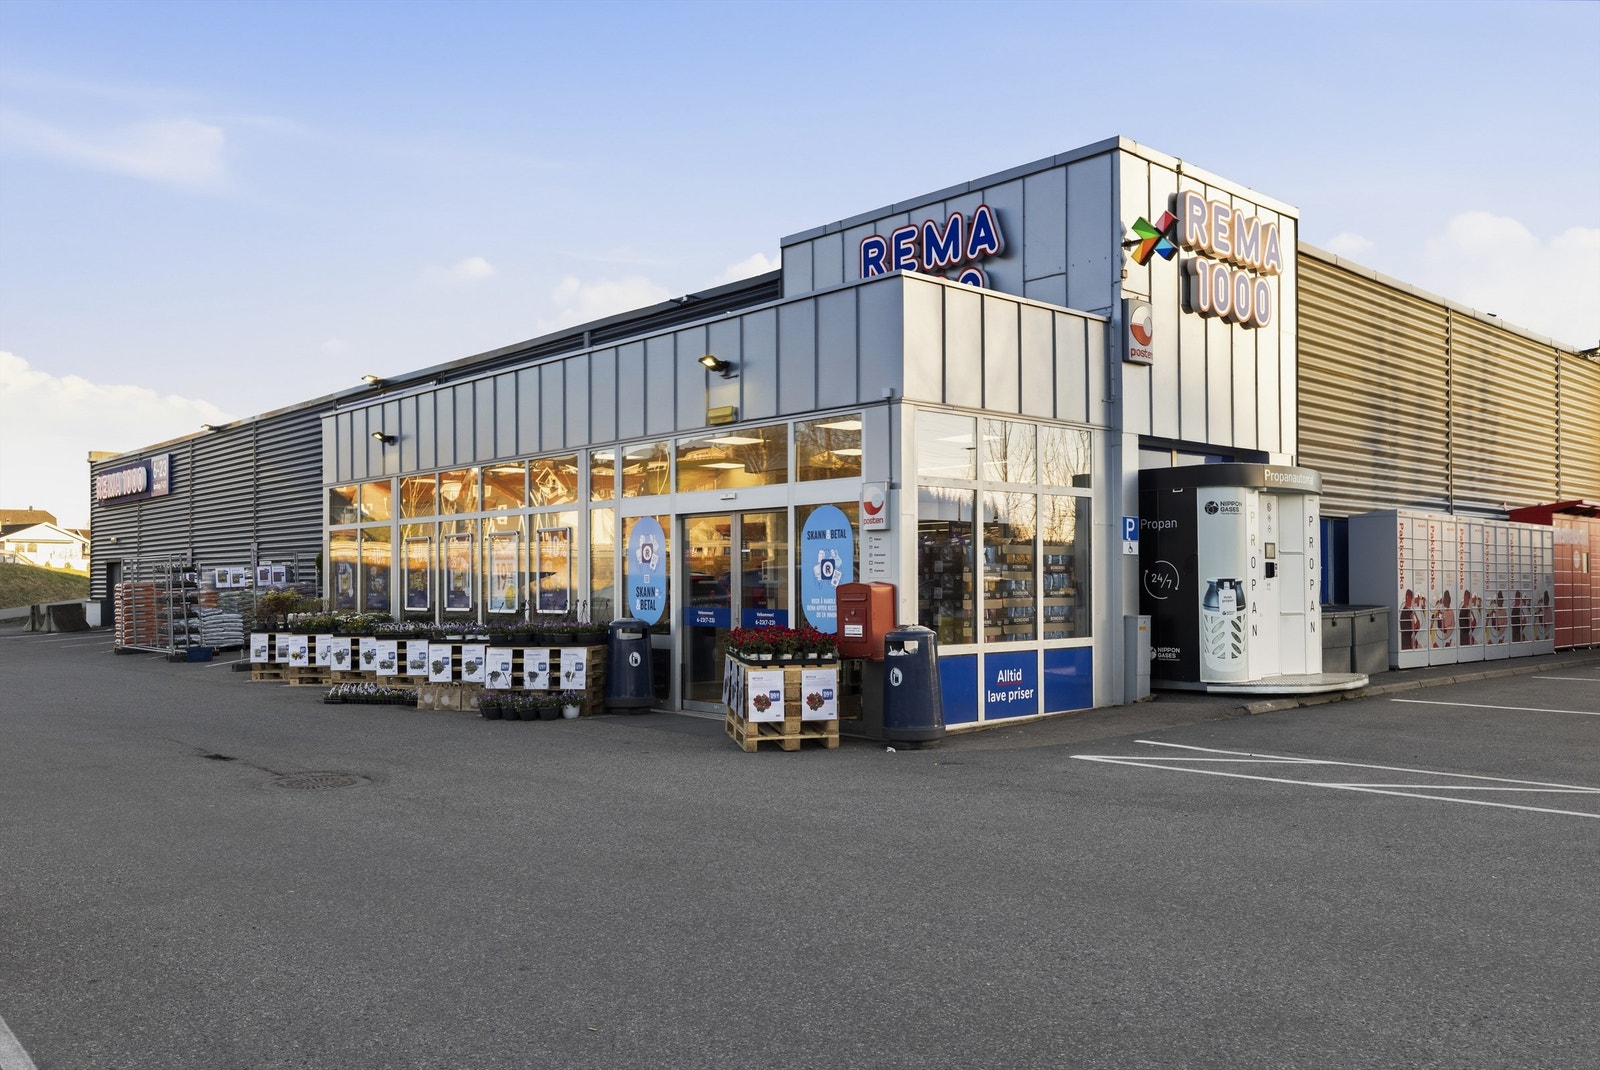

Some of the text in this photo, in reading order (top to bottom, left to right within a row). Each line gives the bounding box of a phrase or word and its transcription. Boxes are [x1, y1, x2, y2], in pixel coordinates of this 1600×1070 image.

[1185, 190, 1283, 275] REMA
[860, 204, 1000, 279] REMA
[1194, 256, 1272, 329] 1000
[1126, 518, 1135, 540] P
[1140, 519, 1178, 531] Propan
[807, 530, 826, 540] SKANN
[830, 528, 847, 538] BETAL
[1151, 573, 1172, 588] 24/7
[1308, 515, 1316, 634] PROPAN
[635, 586, 656, 597] SKANN
[640, 600, 656, 610] BETAL
[997, 668, 1022, 682] Alltid
[987, 687, 1034, 703] lave priser
